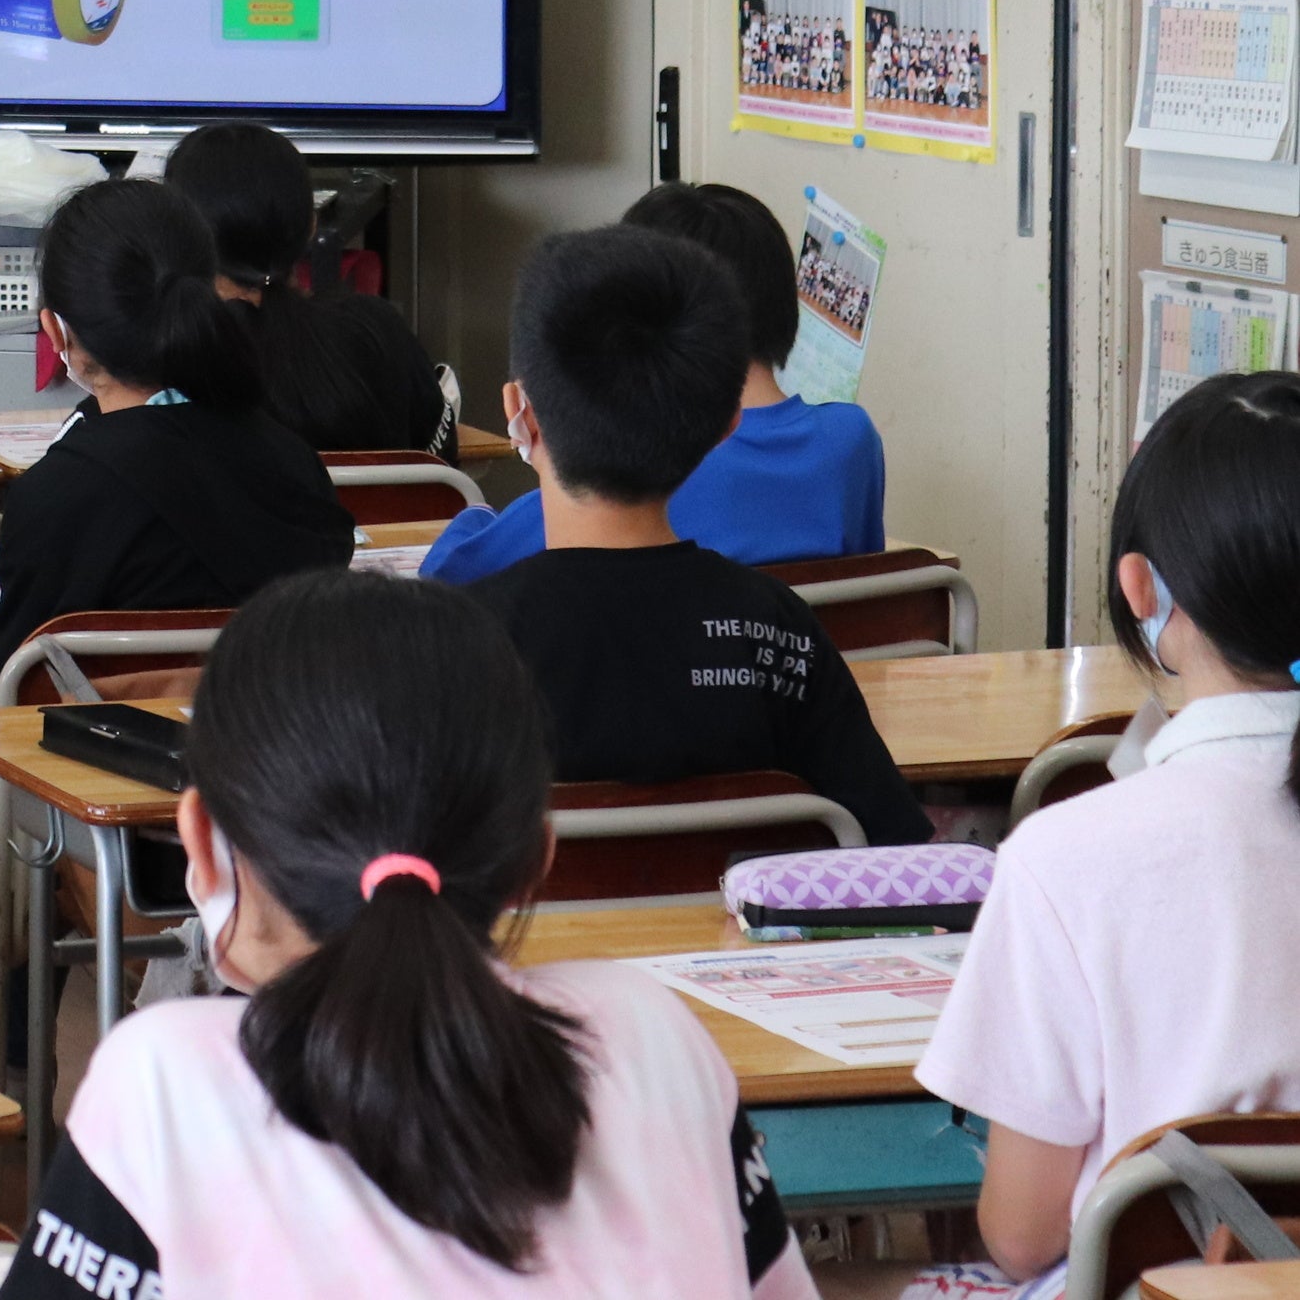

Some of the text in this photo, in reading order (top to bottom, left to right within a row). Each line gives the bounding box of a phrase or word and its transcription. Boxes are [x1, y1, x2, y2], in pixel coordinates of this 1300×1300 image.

[1180, 241, 1268, 275] きゅう食当番
[703, 619, 742, 638] THE
[757, 647, 774, 666] IS
